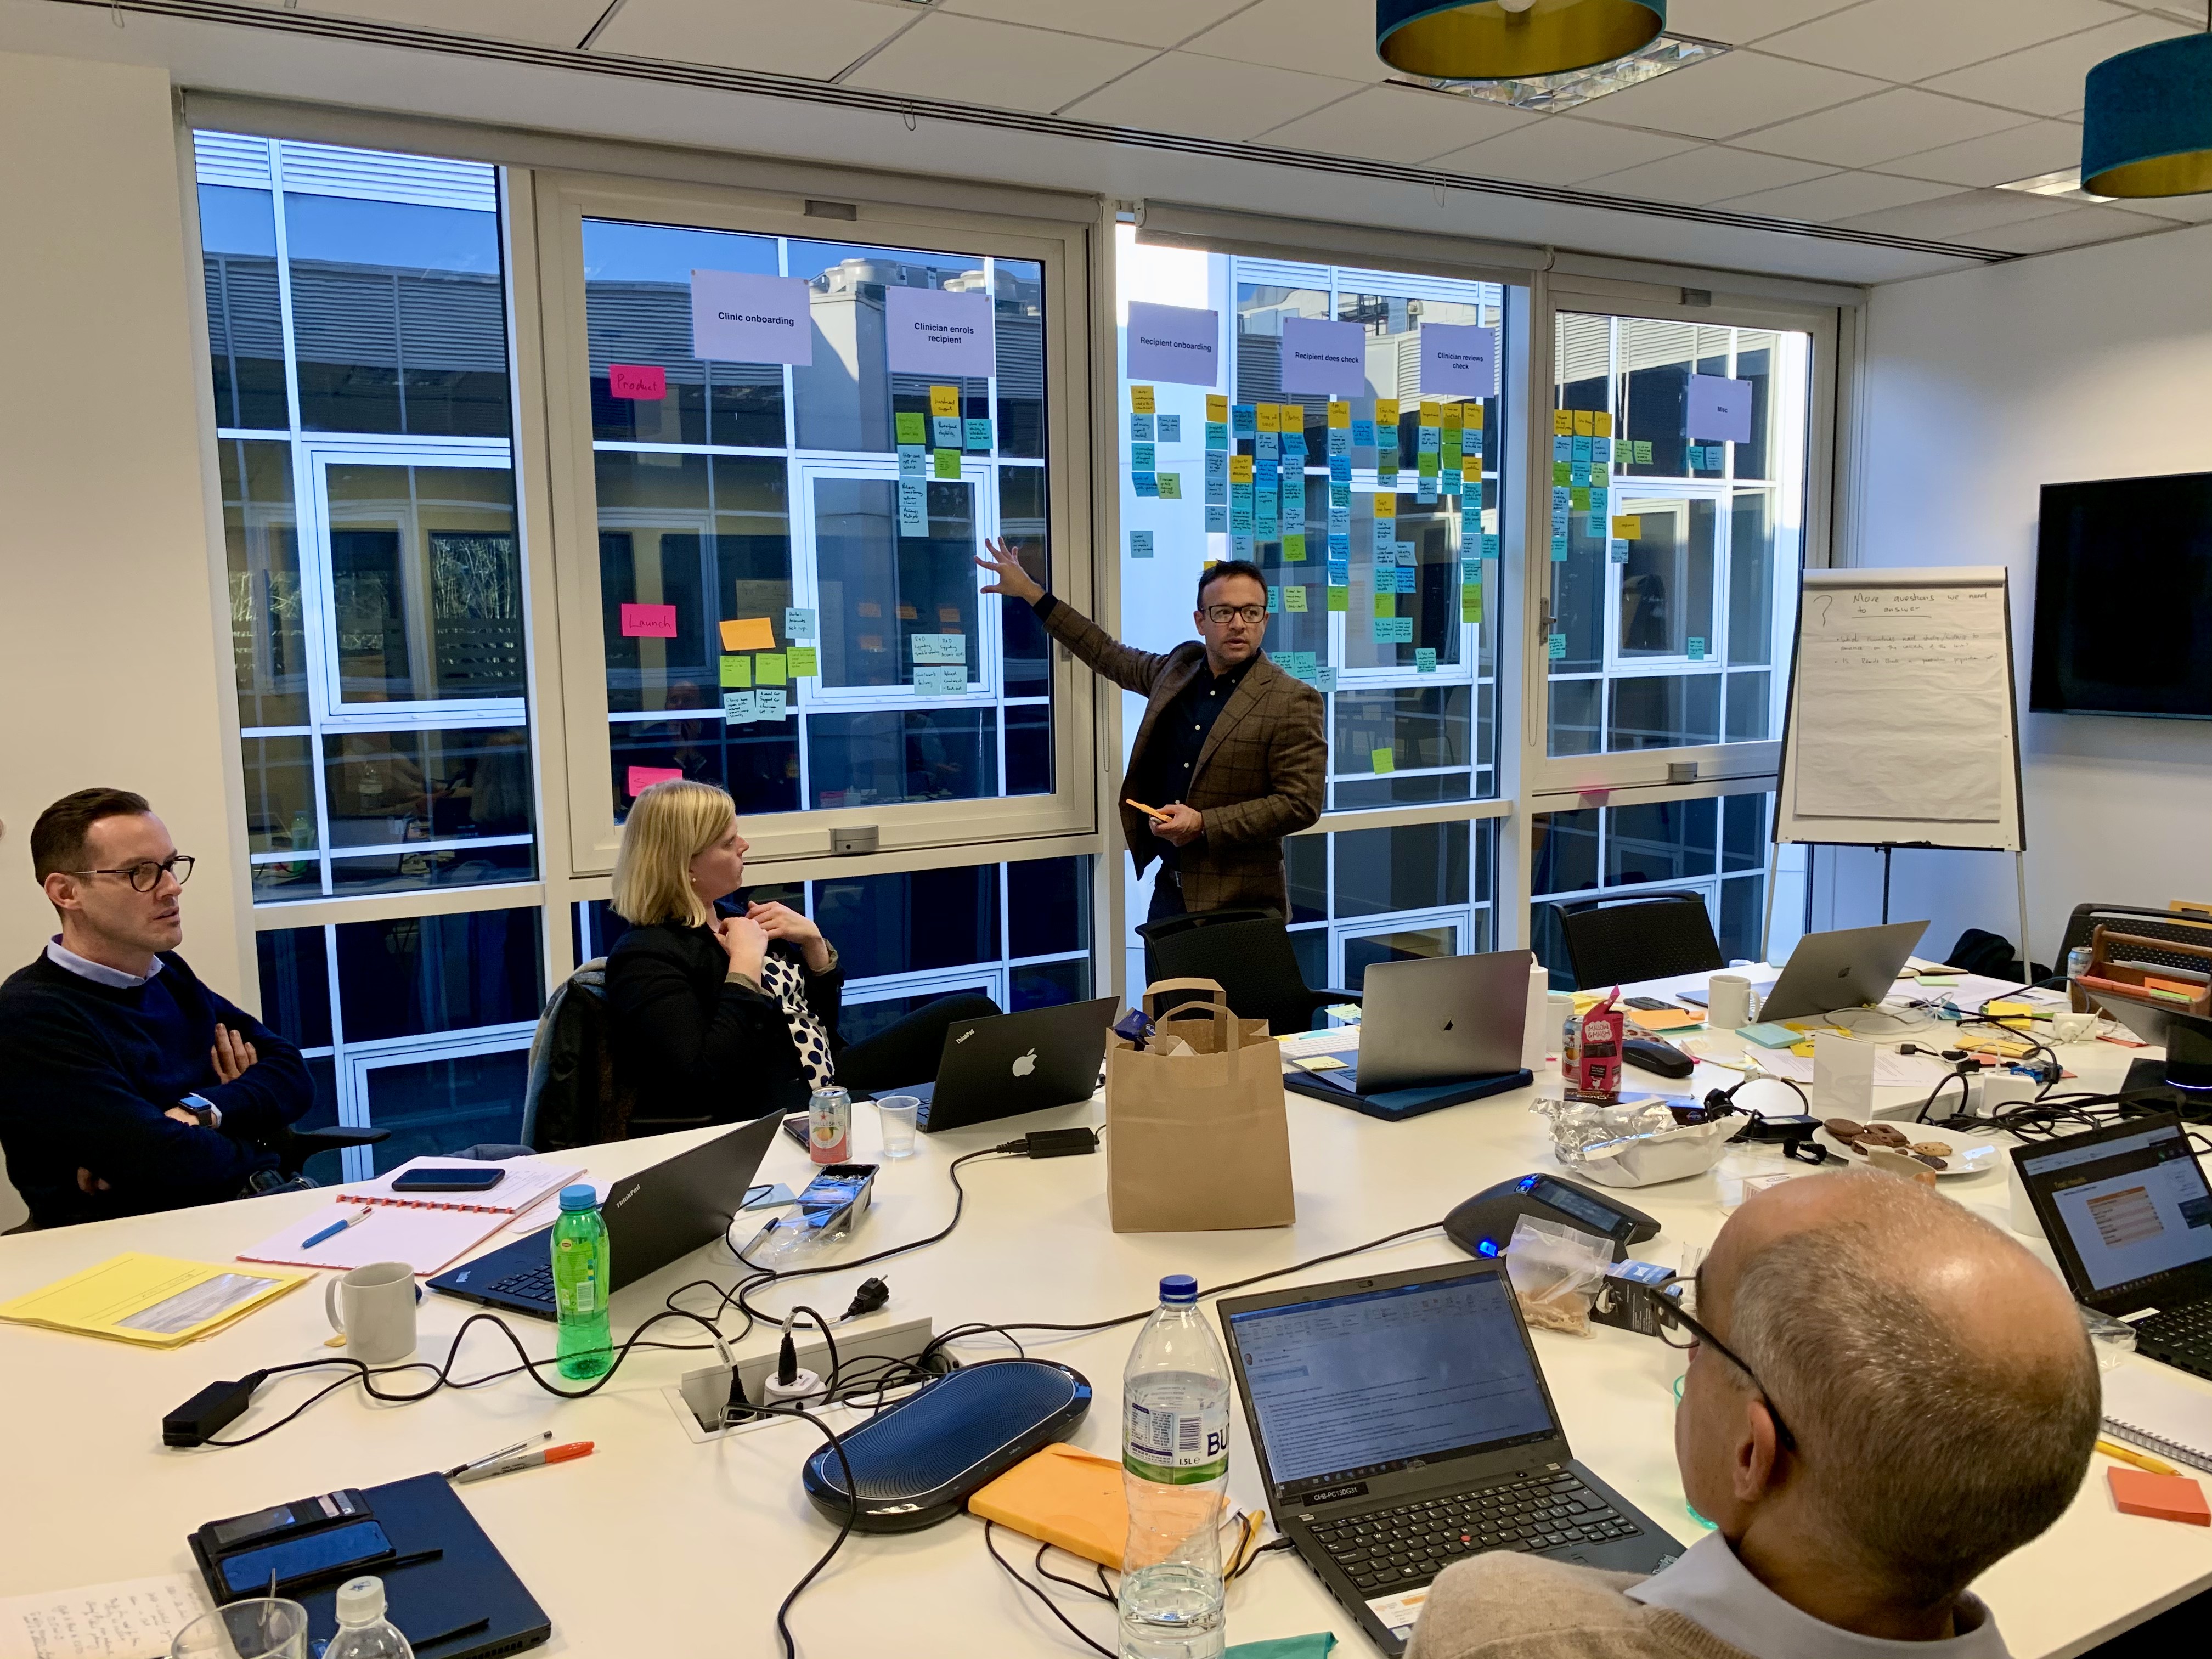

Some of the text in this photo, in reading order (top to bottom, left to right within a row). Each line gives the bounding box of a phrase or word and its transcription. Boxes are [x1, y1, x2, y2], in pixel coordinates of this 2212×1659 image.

[718, 312, 794, 327] Clinic onboarding
[915, 322, 948, 332] Clinician
[928, 335, 962, 344] recipient
[1141, 337, 1211, 353] Recipient onboarding
[1295, 352, 1324, 361] Recipient
[1437, 352, 1462, 360] Clinician
[617, 373, 657, 391] Product
[1853, 592, 1880, 603] More
[1893, 594, 1935, 602] questions
[629, 614, 672, 629] Launch
[1588, 1024, 1609, 1032] MALLOW
[1592, 1029, 1610, 1038] MARSH
[616, 1184, 640, 1208] ThinkPad
